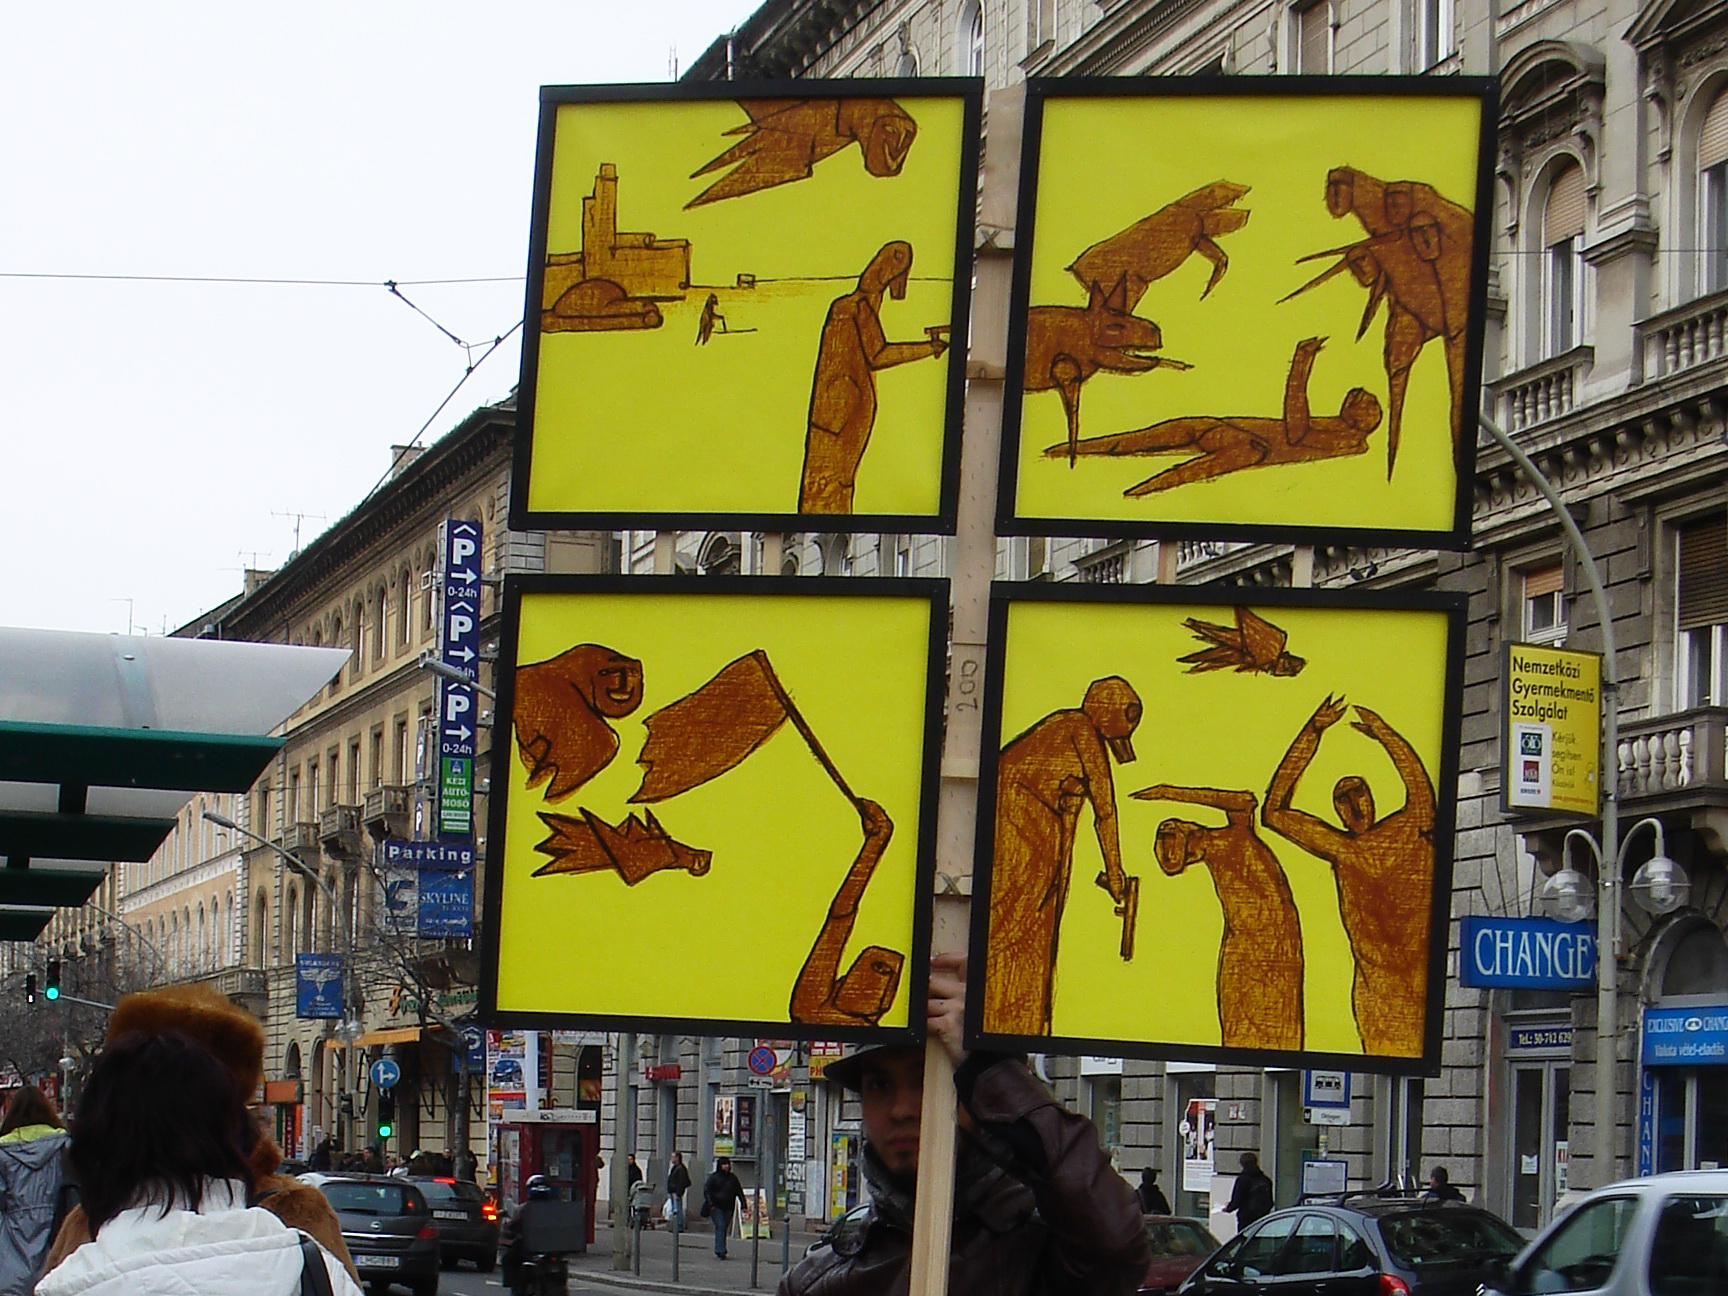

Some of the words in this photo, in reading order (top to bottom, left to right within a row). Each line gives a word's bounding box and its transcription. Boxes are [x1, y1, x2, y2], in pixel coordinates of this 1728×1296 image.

[452, 537, 476, 565] P
[447, 586, 477, 599] 0-24h
[450, 614, 473, 642] P
[1512, 656, 1581, 679] Nemzetközi
[1512, 678, 1595, 703] Gyermekmentő
[446, 693, 470, 722] P
[1512, 699, 1568, 722] Szolgálat
[442, 742, 473, 755] 0-24h
[388, 846, 472, 865] Parking
[420, 892, 469, 905] SKYLINE
[1474, 928, 1593, 980] CHANGE
[1647, 1018, 1685, 1034] EXCLUSIVE
[786, 1162, 806, 1180] GSM
